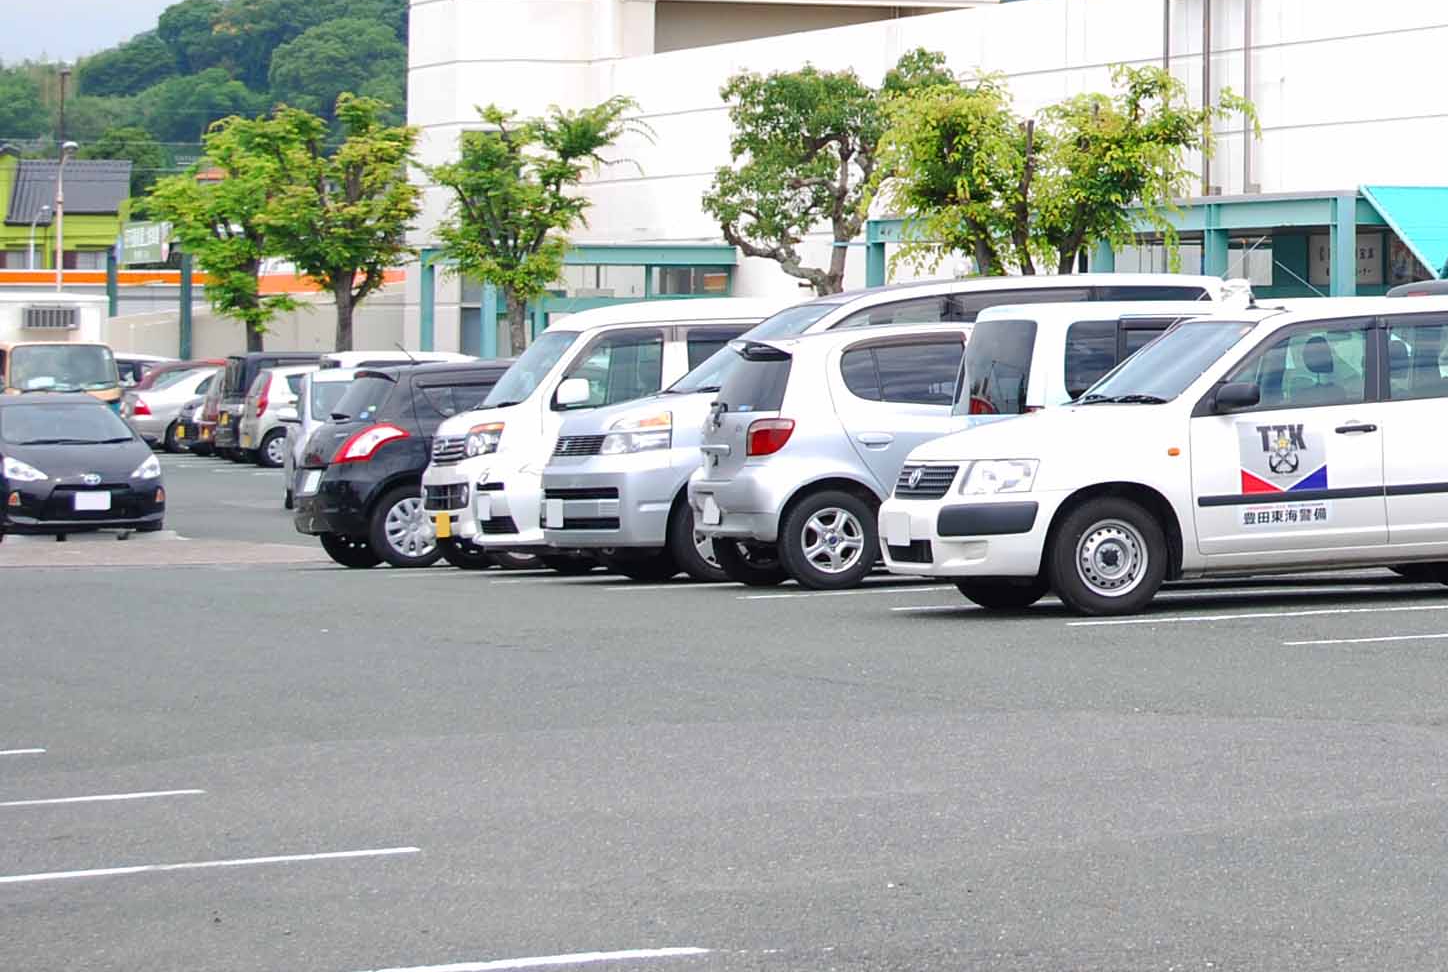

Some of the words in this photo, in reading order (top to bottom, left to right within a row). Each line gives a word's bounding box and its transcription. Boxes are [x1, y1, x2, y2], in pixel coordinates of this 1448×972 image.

[1256, 424, 1306, 452] TTK
[1243, 507, 1327, 525] 豊田東海警備
